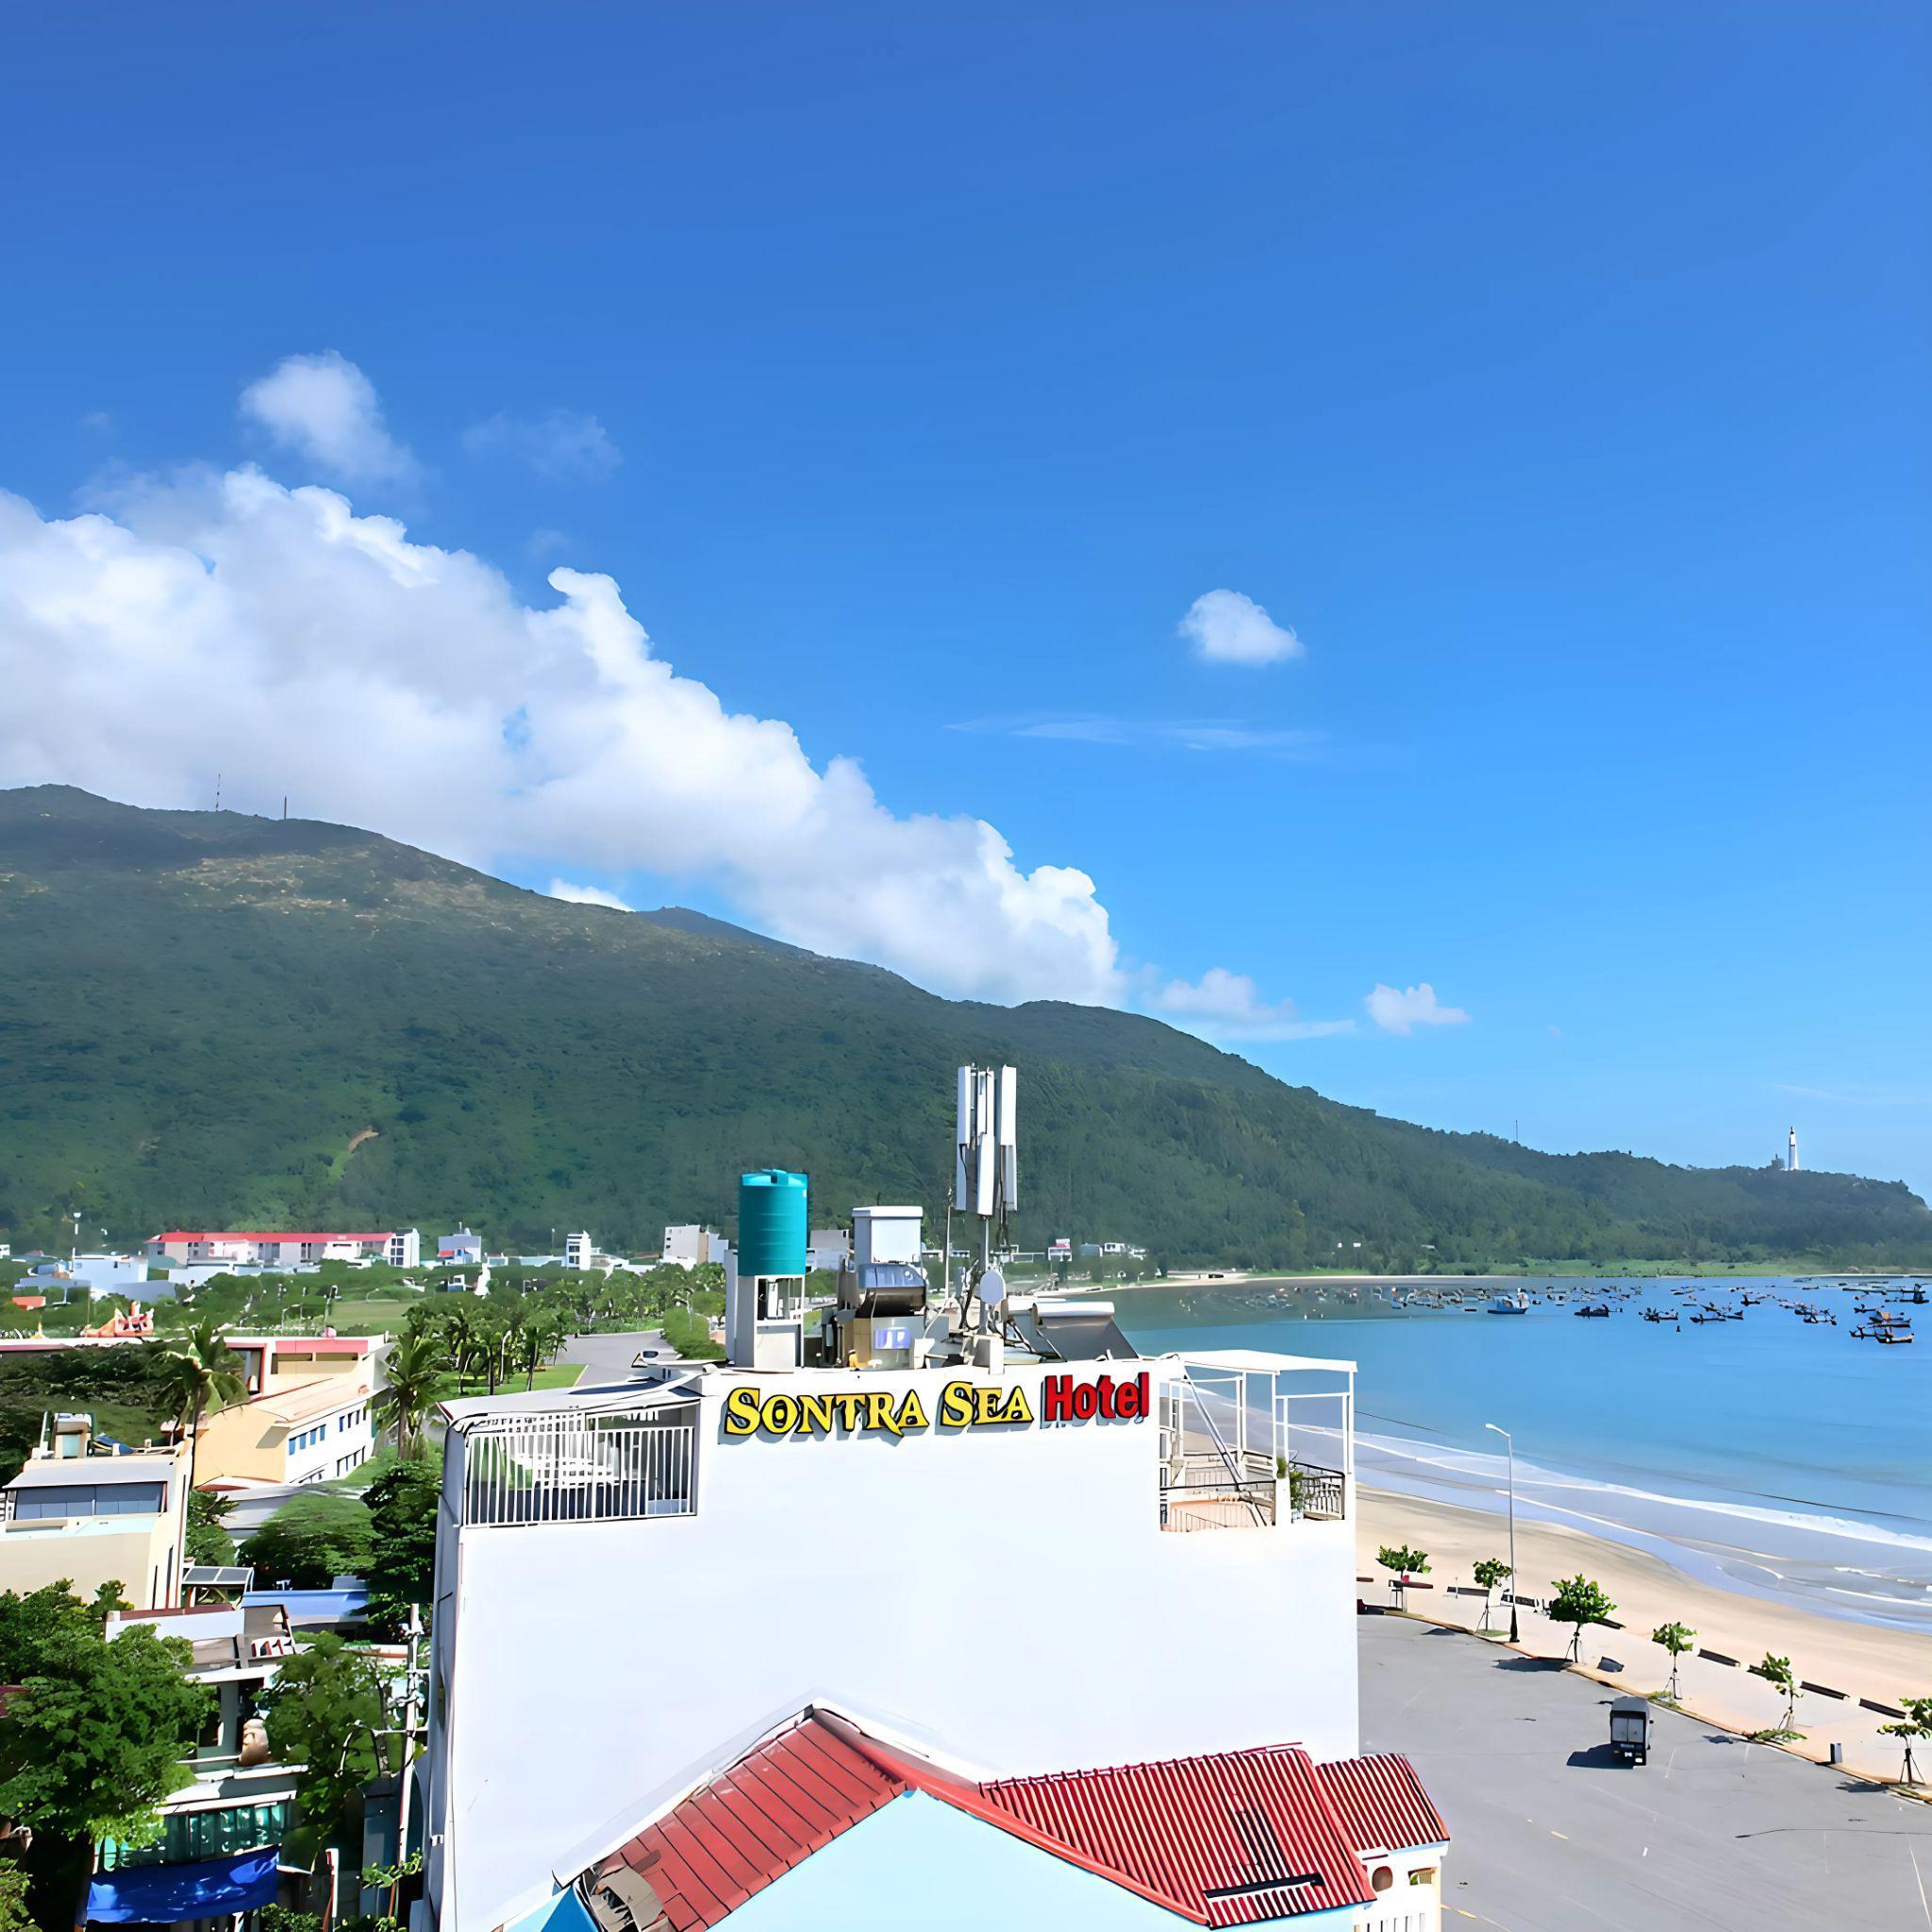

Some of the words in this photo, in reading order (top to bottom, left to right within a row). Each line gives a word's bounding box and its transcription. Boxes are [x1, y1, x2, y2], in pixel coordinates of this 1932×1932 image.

[724, 1387, 929, 1437] SONTRA
[940, 1381, 1035, 1427] SEA
[1043, 1372, 1150, 1422] Hotel
